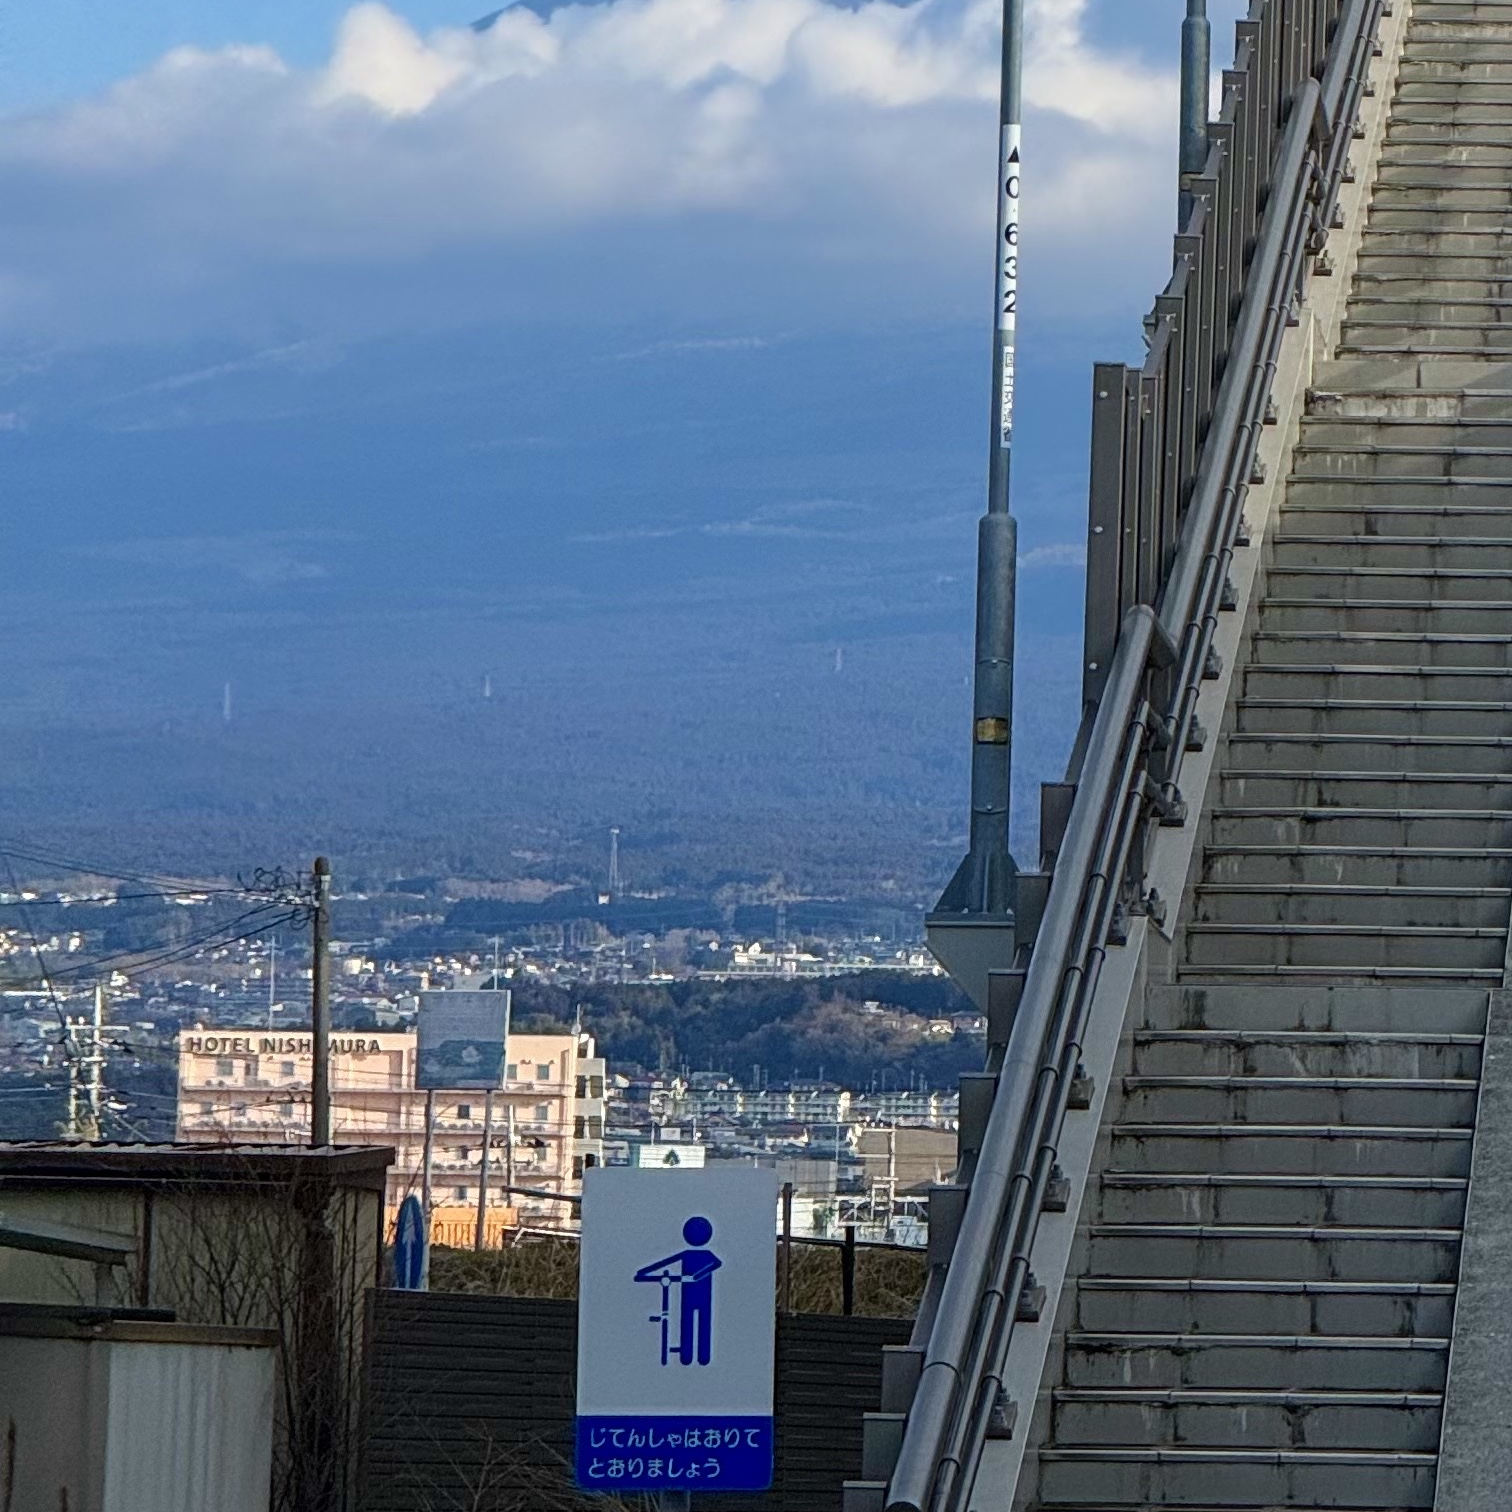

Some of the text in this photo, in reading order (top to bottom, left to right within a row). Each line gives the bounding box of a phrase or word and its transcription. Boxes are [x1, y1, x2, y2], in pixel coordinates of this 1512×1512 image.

[189, 1037, 380, 1054] HOTEL NISHMURA
[590, 1428, 761, 1449] じてんしゃはおりて
[588, 1457, 721, 1479] とおりましょう
